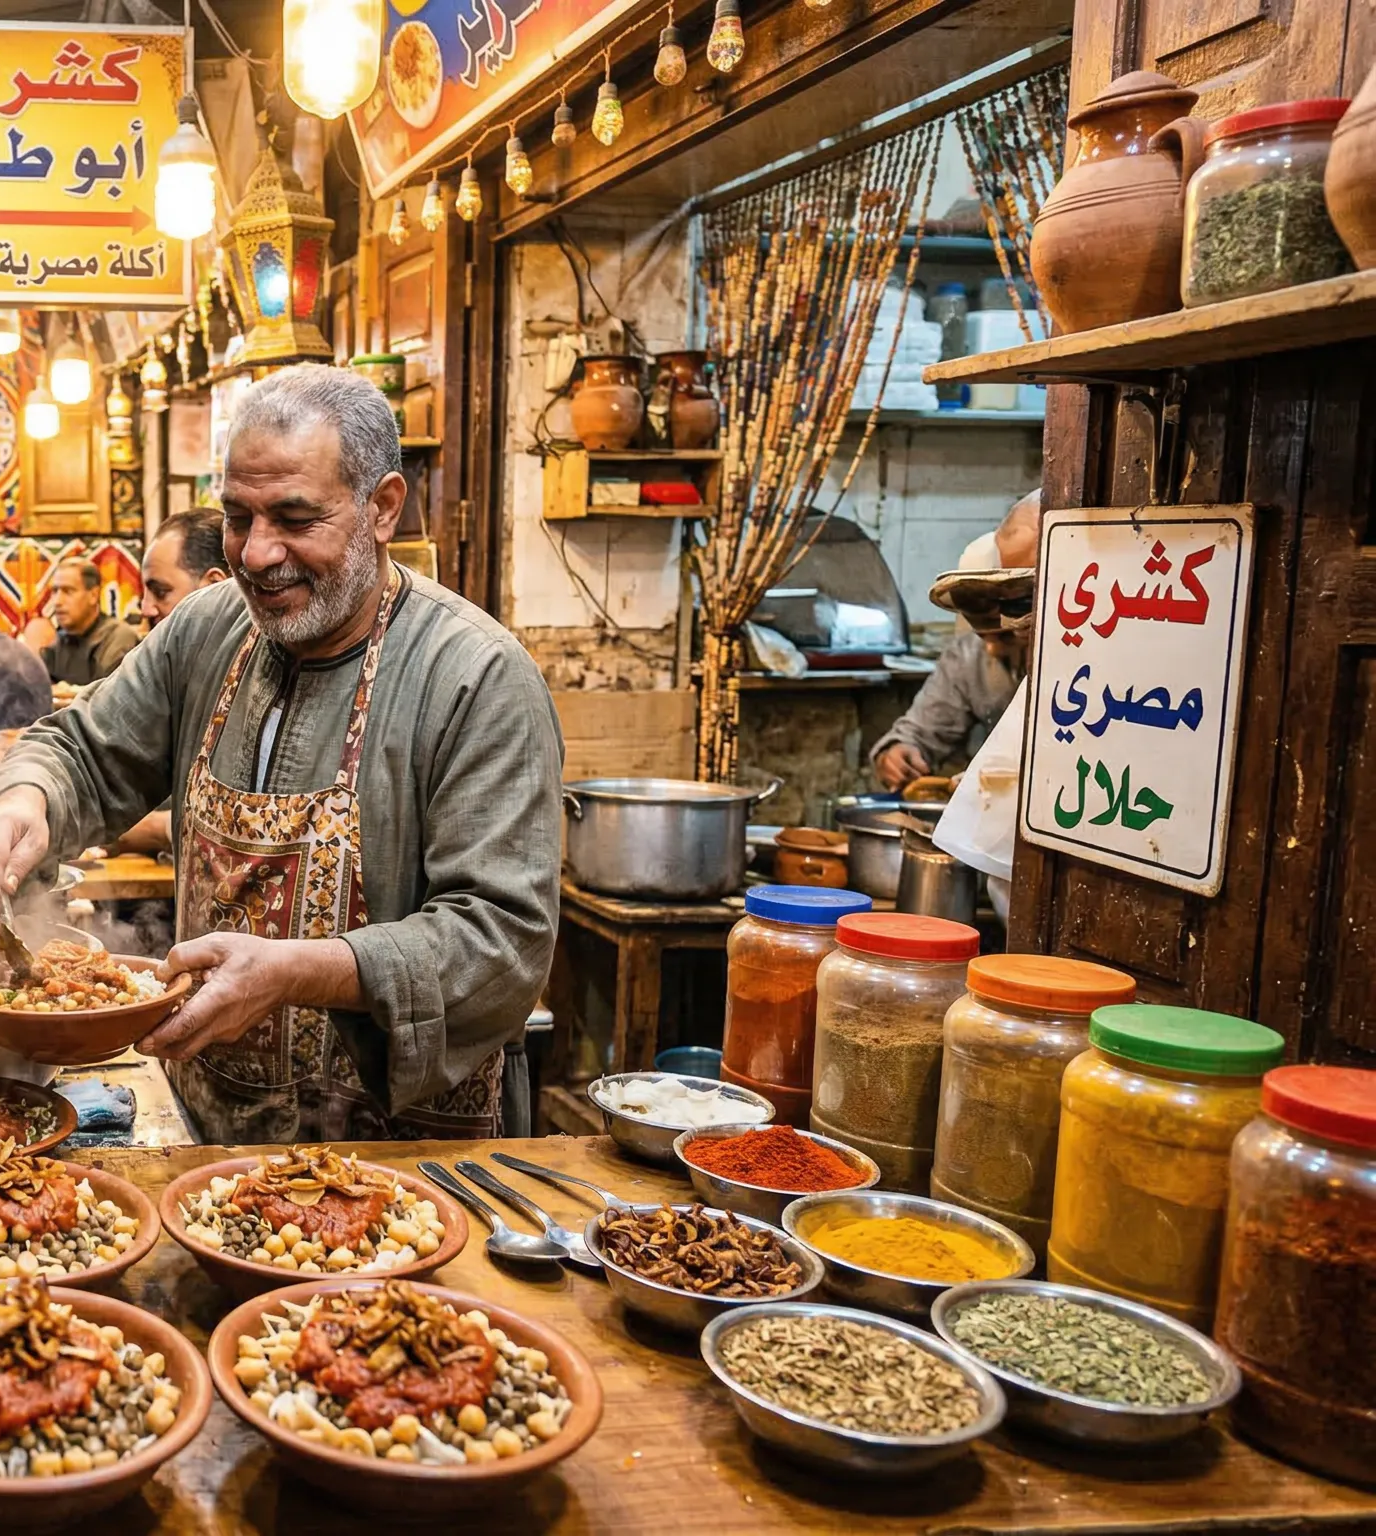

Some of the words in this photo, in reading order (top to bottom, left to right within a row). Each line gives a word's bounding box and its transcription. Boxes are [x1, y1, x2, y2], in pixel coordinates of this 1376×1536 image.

[64, 120, 144, 198] أبو
[107, 241, 166, 278] أكلة
[1057, 539, 1215, 648] كشري
[1051, 664, 1204, 745] مصري
[1054, 754, 1175, 832] حلال
